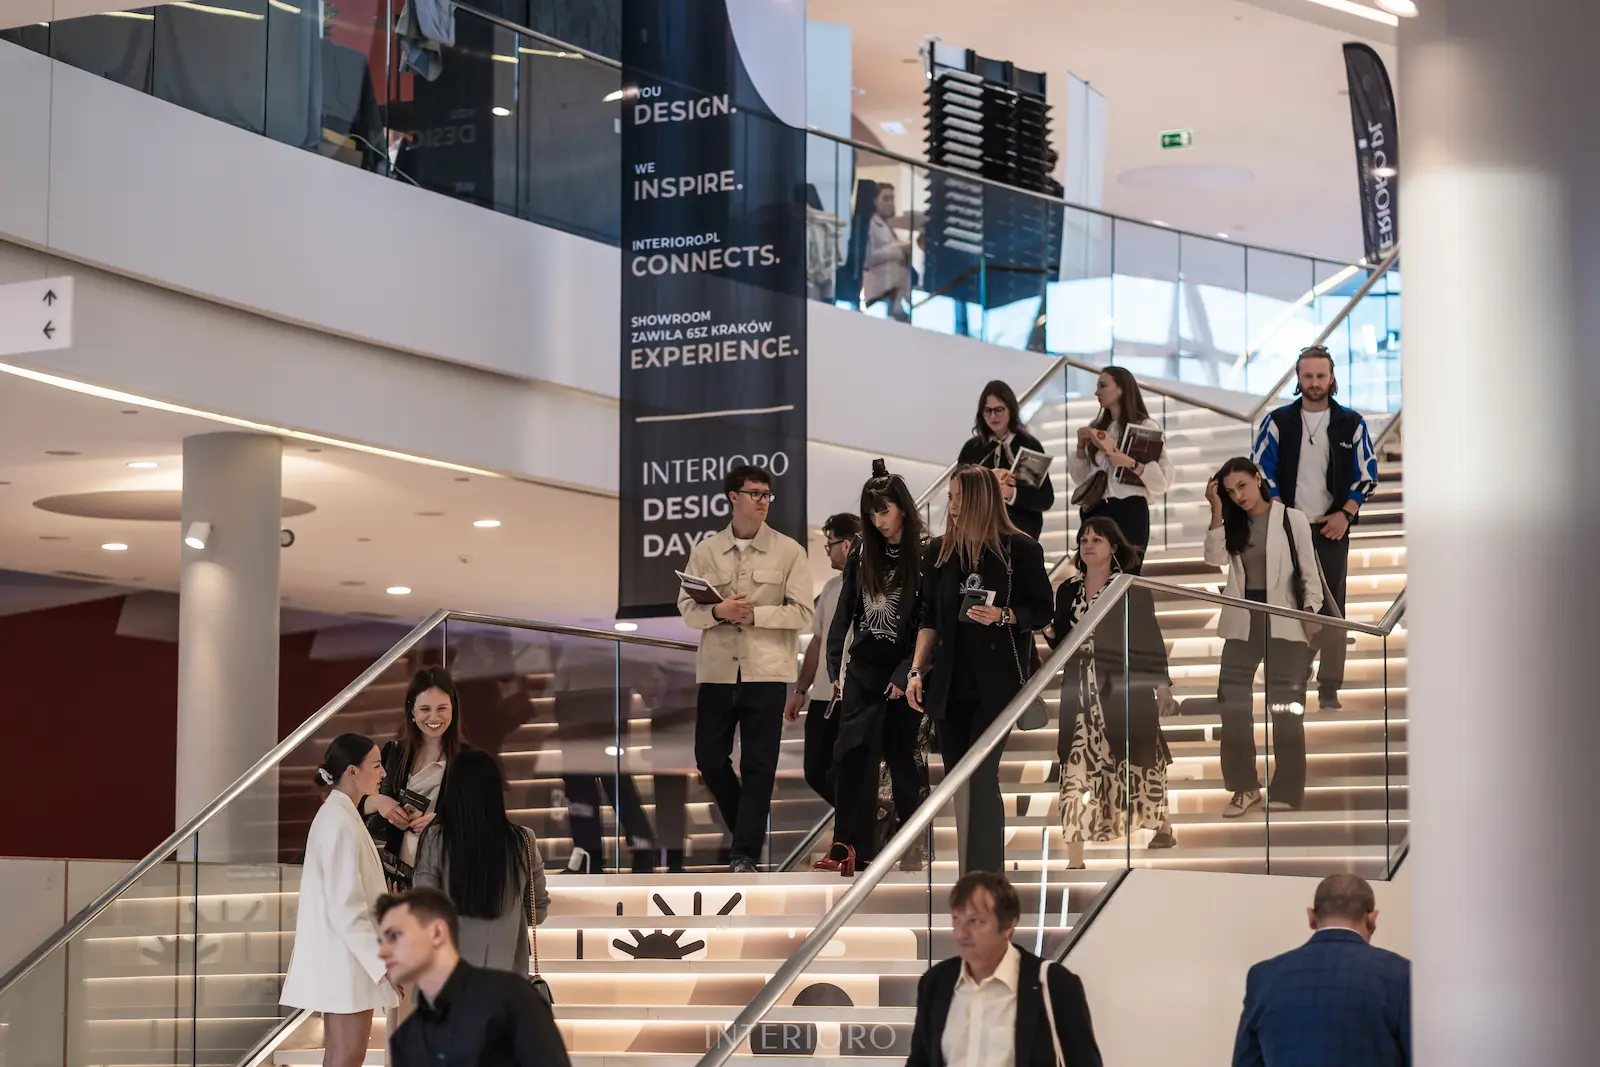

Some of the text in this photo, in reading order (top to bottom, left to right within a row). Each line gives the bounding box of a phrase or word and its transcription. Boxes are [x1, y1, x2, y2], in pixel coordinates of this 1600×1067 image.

[634, 94, 737, 125] DESIGN.
[635, 162, 656, 175] WE
[634, 170, 744, 201] INSPIRE.
[632, 232, 721, 251] INTERIORO.PL
[631, 244, 781, 277] CONNECTS.
[631, 310, 711, 328] SHOWROOM
[631, 329, 683, 343] ZAWIŁA
[711, 319, 773, 336] KRAKÓW
[631, 335, 799, 370] EXPERIENCE.
[643, 493, 729, 521] DESIG
